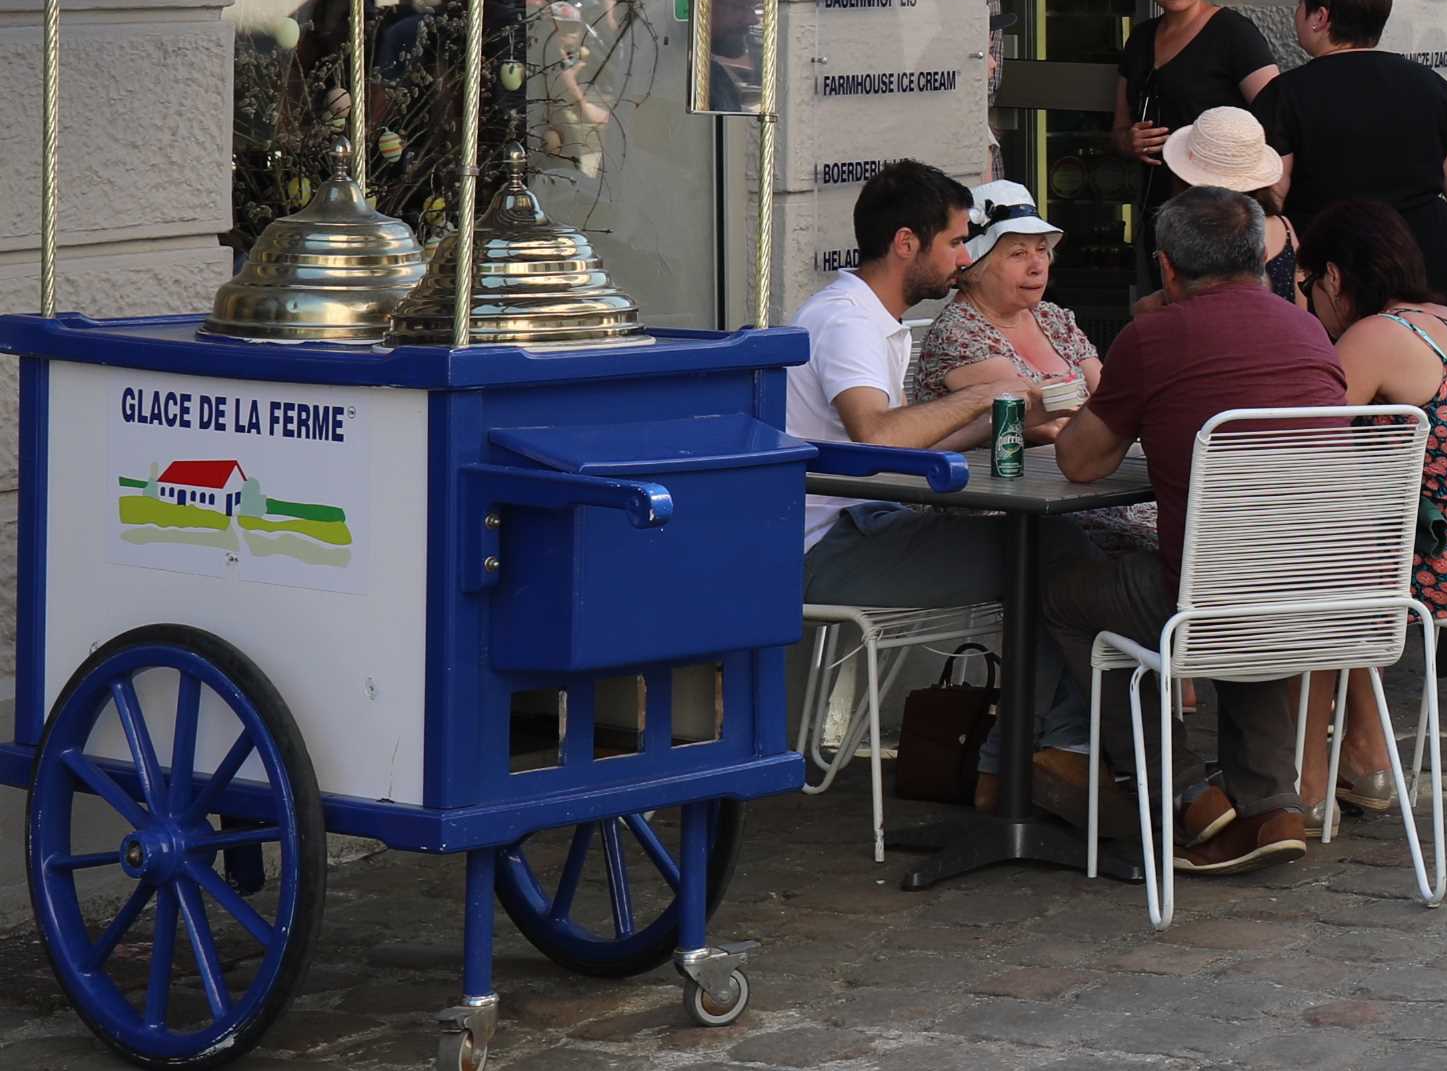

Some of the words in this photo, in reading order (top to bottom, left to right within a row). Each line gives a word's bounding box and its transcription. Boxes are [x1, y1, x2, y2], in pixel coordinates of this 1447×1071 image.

[823, 74, 894, 96] FARMHOUSE
[897, 72, 915, 93] ICE
[917, 70, 957, 92] CREAM
[121, 387, 192, 428] GLACE
[199, 395, 227, 431] DE
[235, 398, 261, 435] LA
[269, 401, 345, 442] FERME
